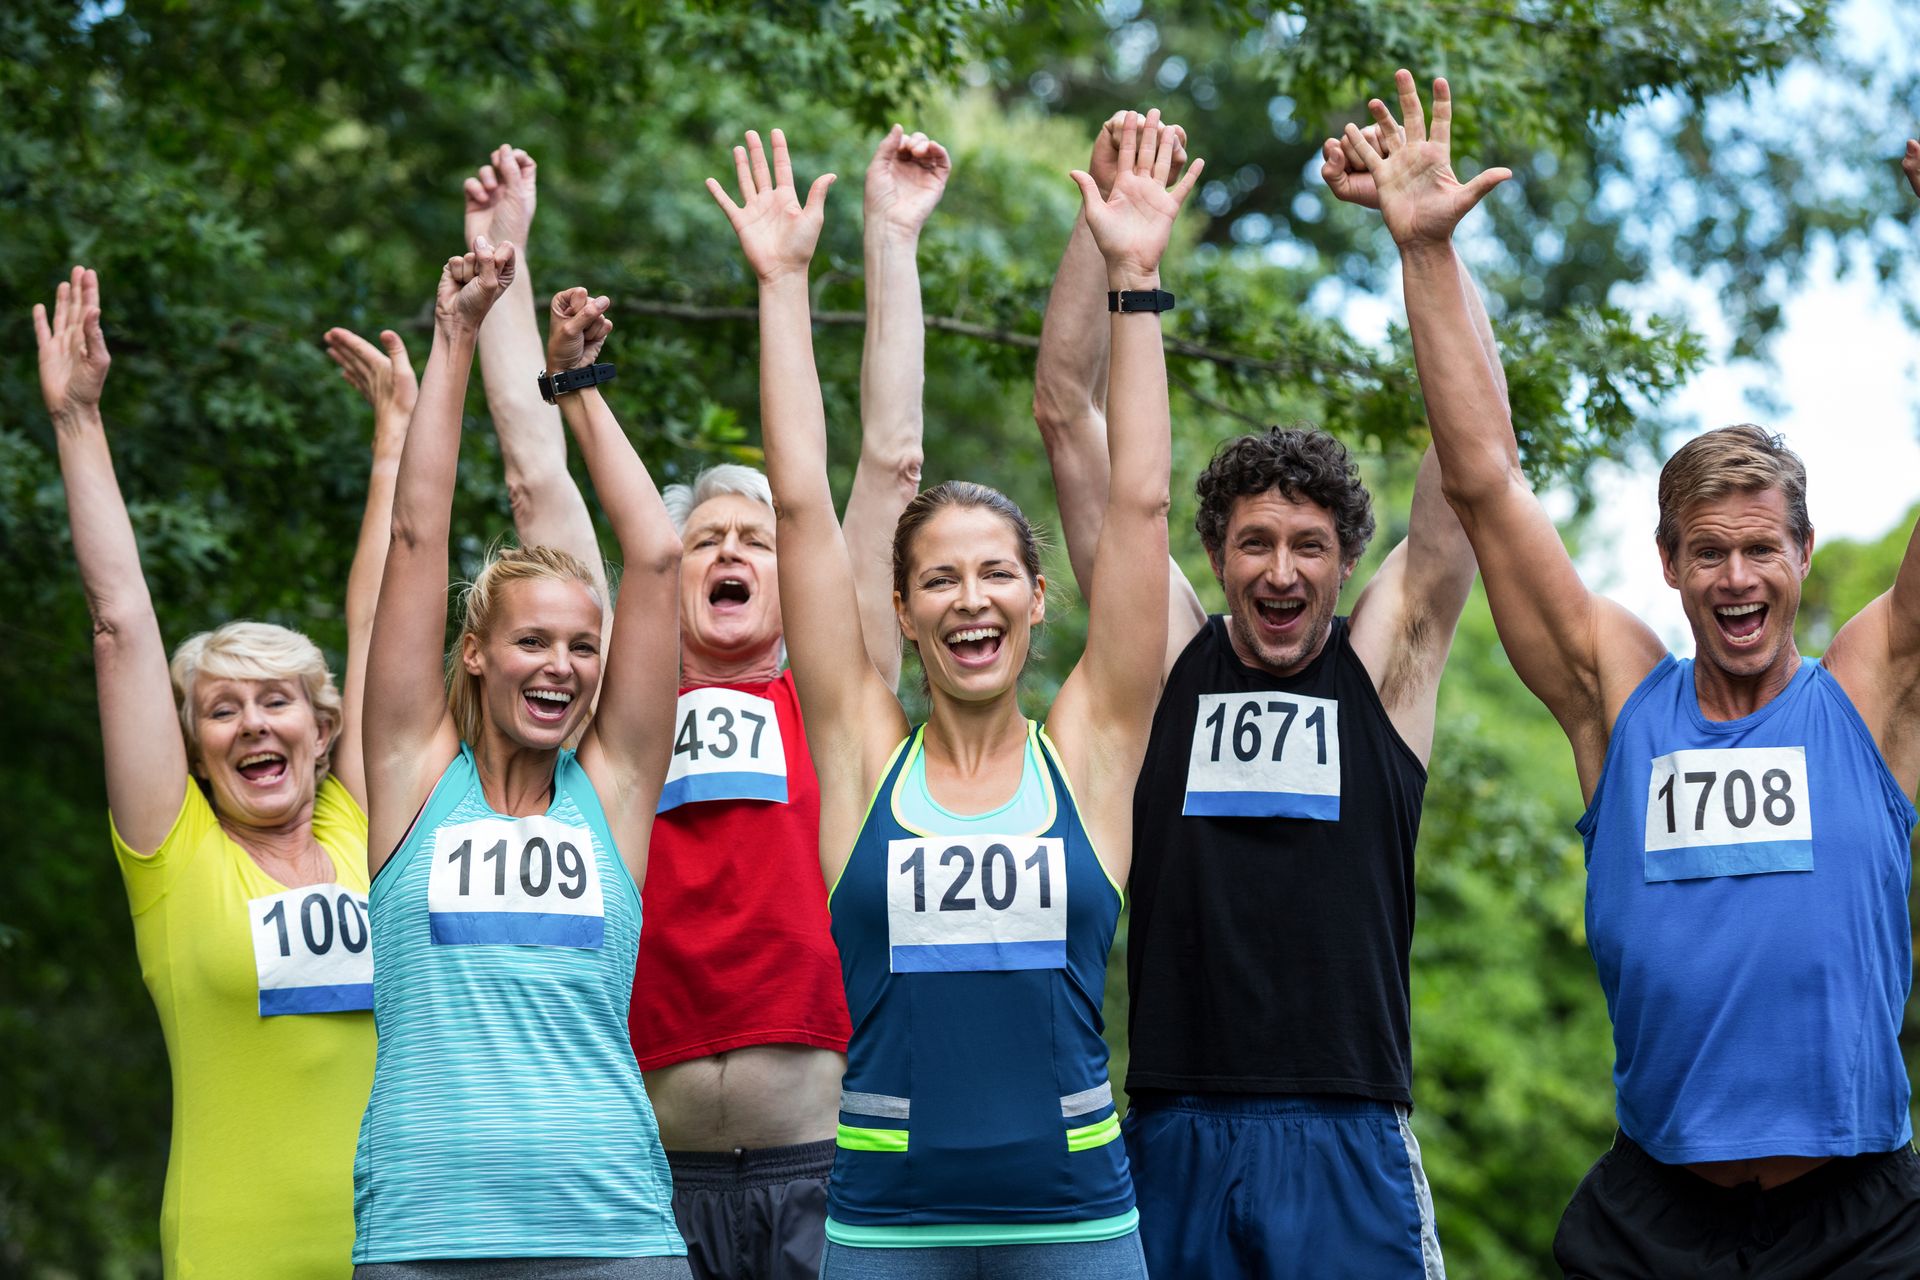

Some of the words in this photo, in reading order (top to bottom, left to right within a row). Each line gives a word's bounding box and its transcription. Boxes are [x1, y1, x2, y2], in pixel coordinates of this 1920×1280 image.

[674, 706, 765, 761] 437
[1205, 701, 1327, 765] 1671
[1658, 768, 1796, 833] 1708
[448, 837, 587, 899] 1109
[900, 844, 1052, 912] 1201
[262, 892, 369, 957] 100
